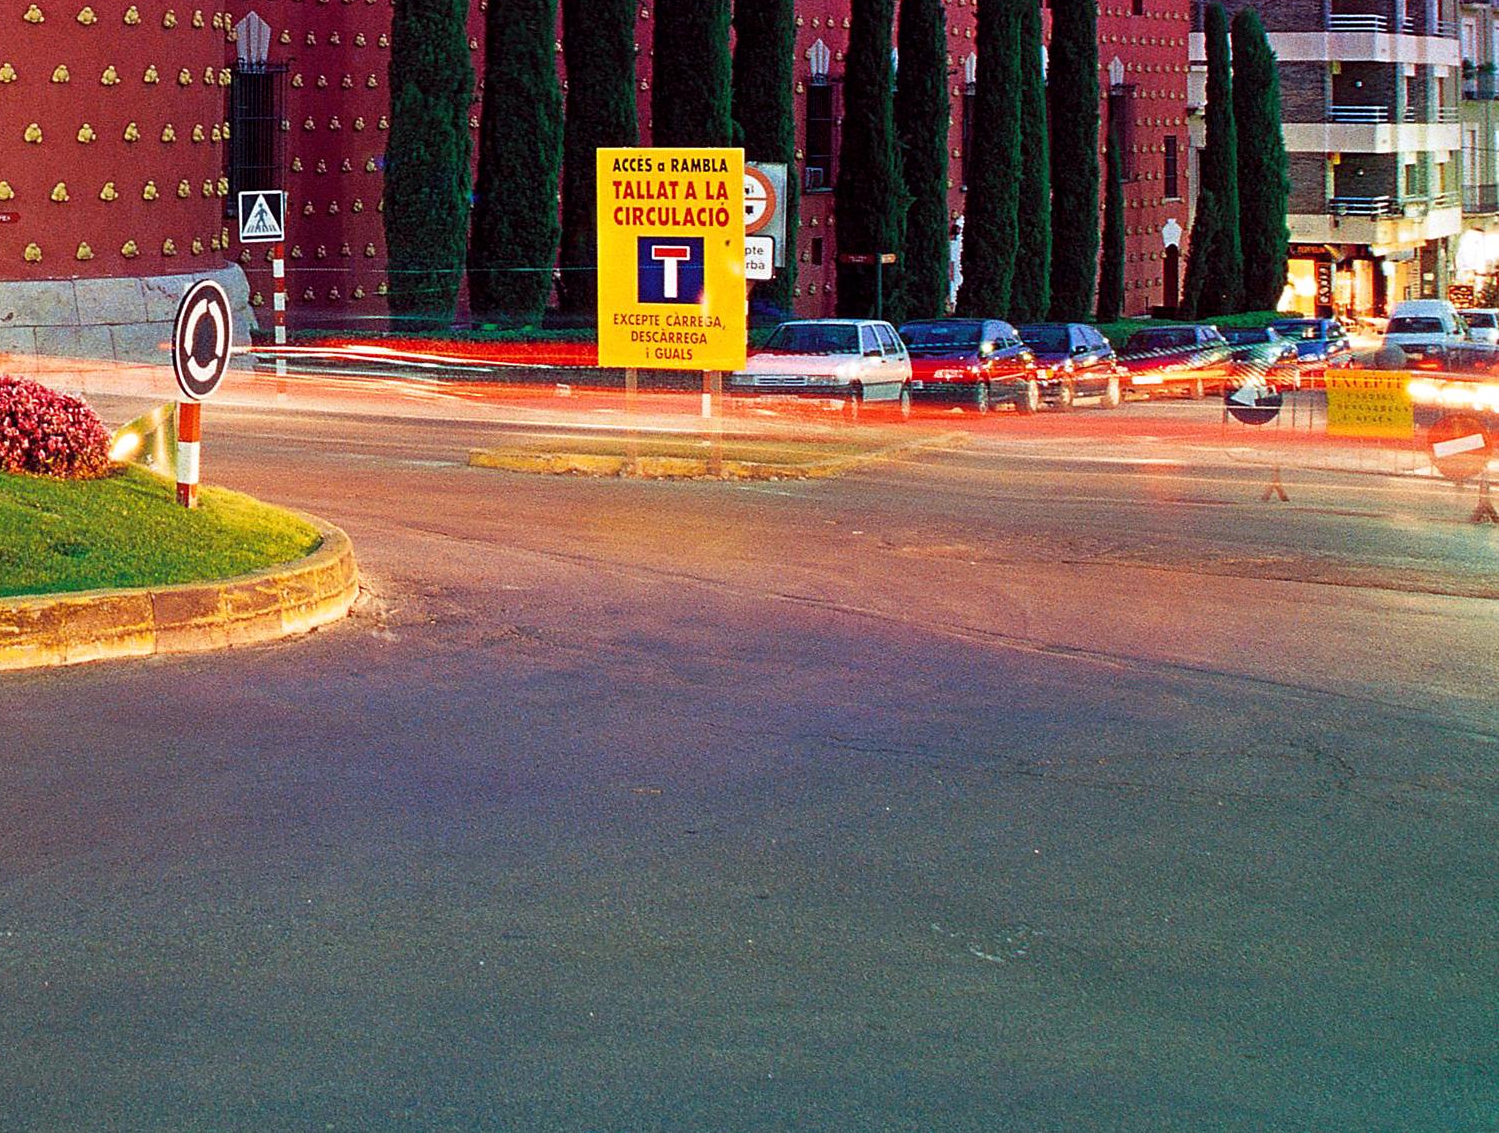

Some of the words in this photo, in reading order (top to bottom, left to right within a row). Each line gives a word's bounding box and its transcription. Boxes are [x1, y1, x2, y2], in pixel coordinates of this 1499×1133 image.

[613, 155, 652, 172] ACCÉS
[657, 161, 665, 172] a
[670, 158, 728, 173] RAMBLA
[613, 180, 678, 200] TALLAT
[684, 181, 697, 200] A
[705, 181, 729, 200] LA
[613, 202, 730, 227] CIRCULACIÓ
[613, 313, 660, 326] EXCEPTE
[631, 328, 708, 344] DESCÀRREGA
[654, 347, 693, 360] GUALS
